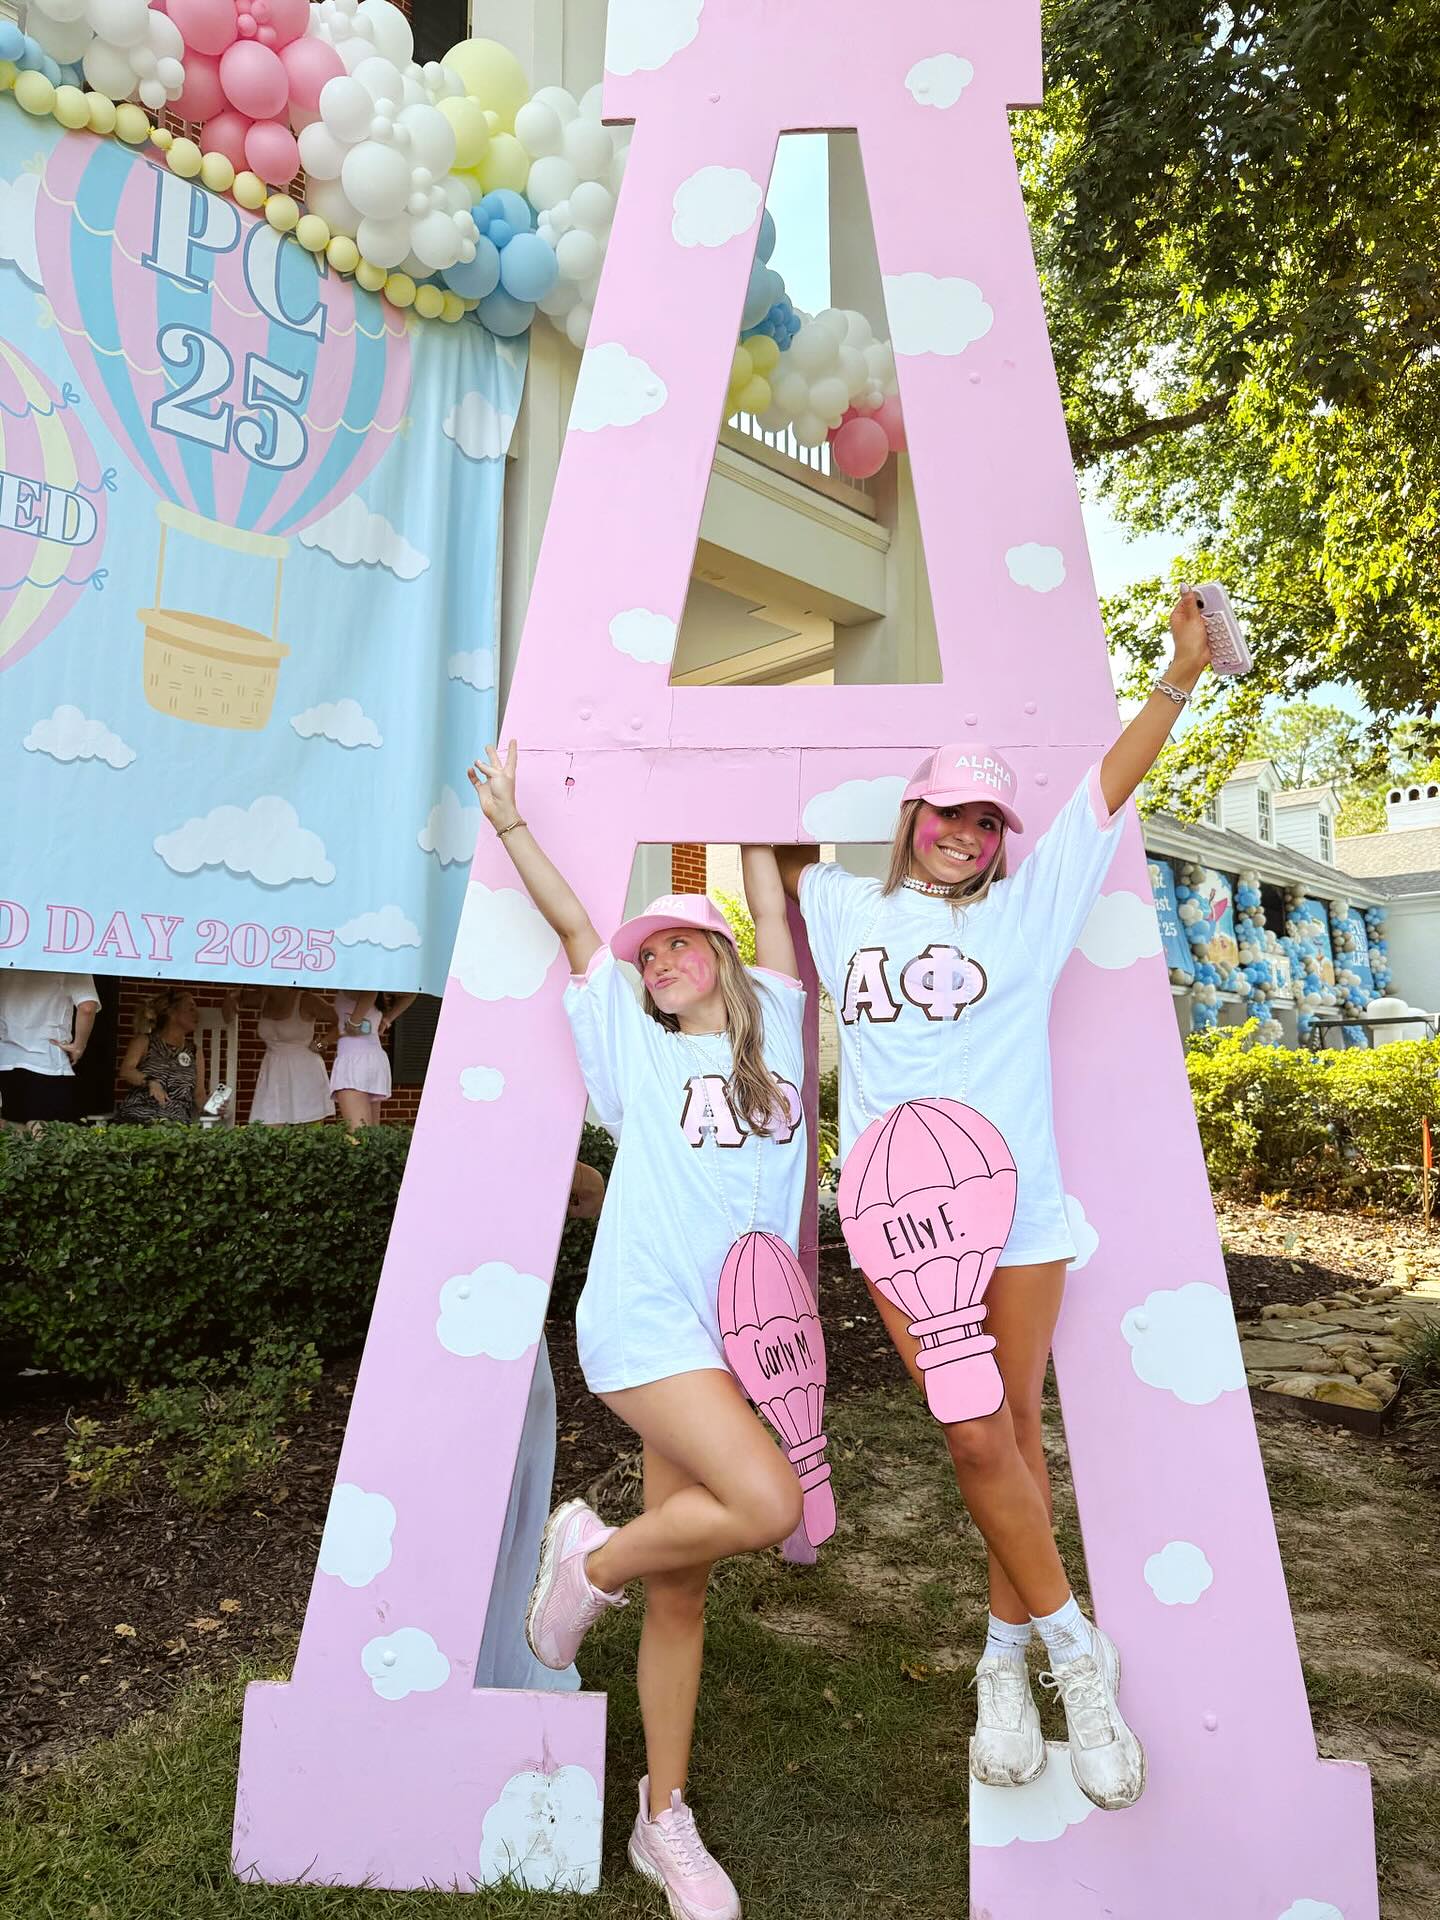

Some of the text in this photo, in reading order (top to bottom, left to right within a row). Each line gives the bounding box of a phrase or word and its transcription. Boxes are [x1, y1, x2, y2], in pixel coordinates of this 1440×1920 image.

[141, 161, 329, 344] PC
[151, 322, 309, 472] 25
[955, 755, 1012, 787] ALPHA
[973, 770, 1002, 791] PHI
[43, 904, 184, 962] DAY
[195, 919, 337, 973] 2025
[882, 1202, 966, 1260] Elly F.
[753, 1330, 816, 1381] Carly M.
